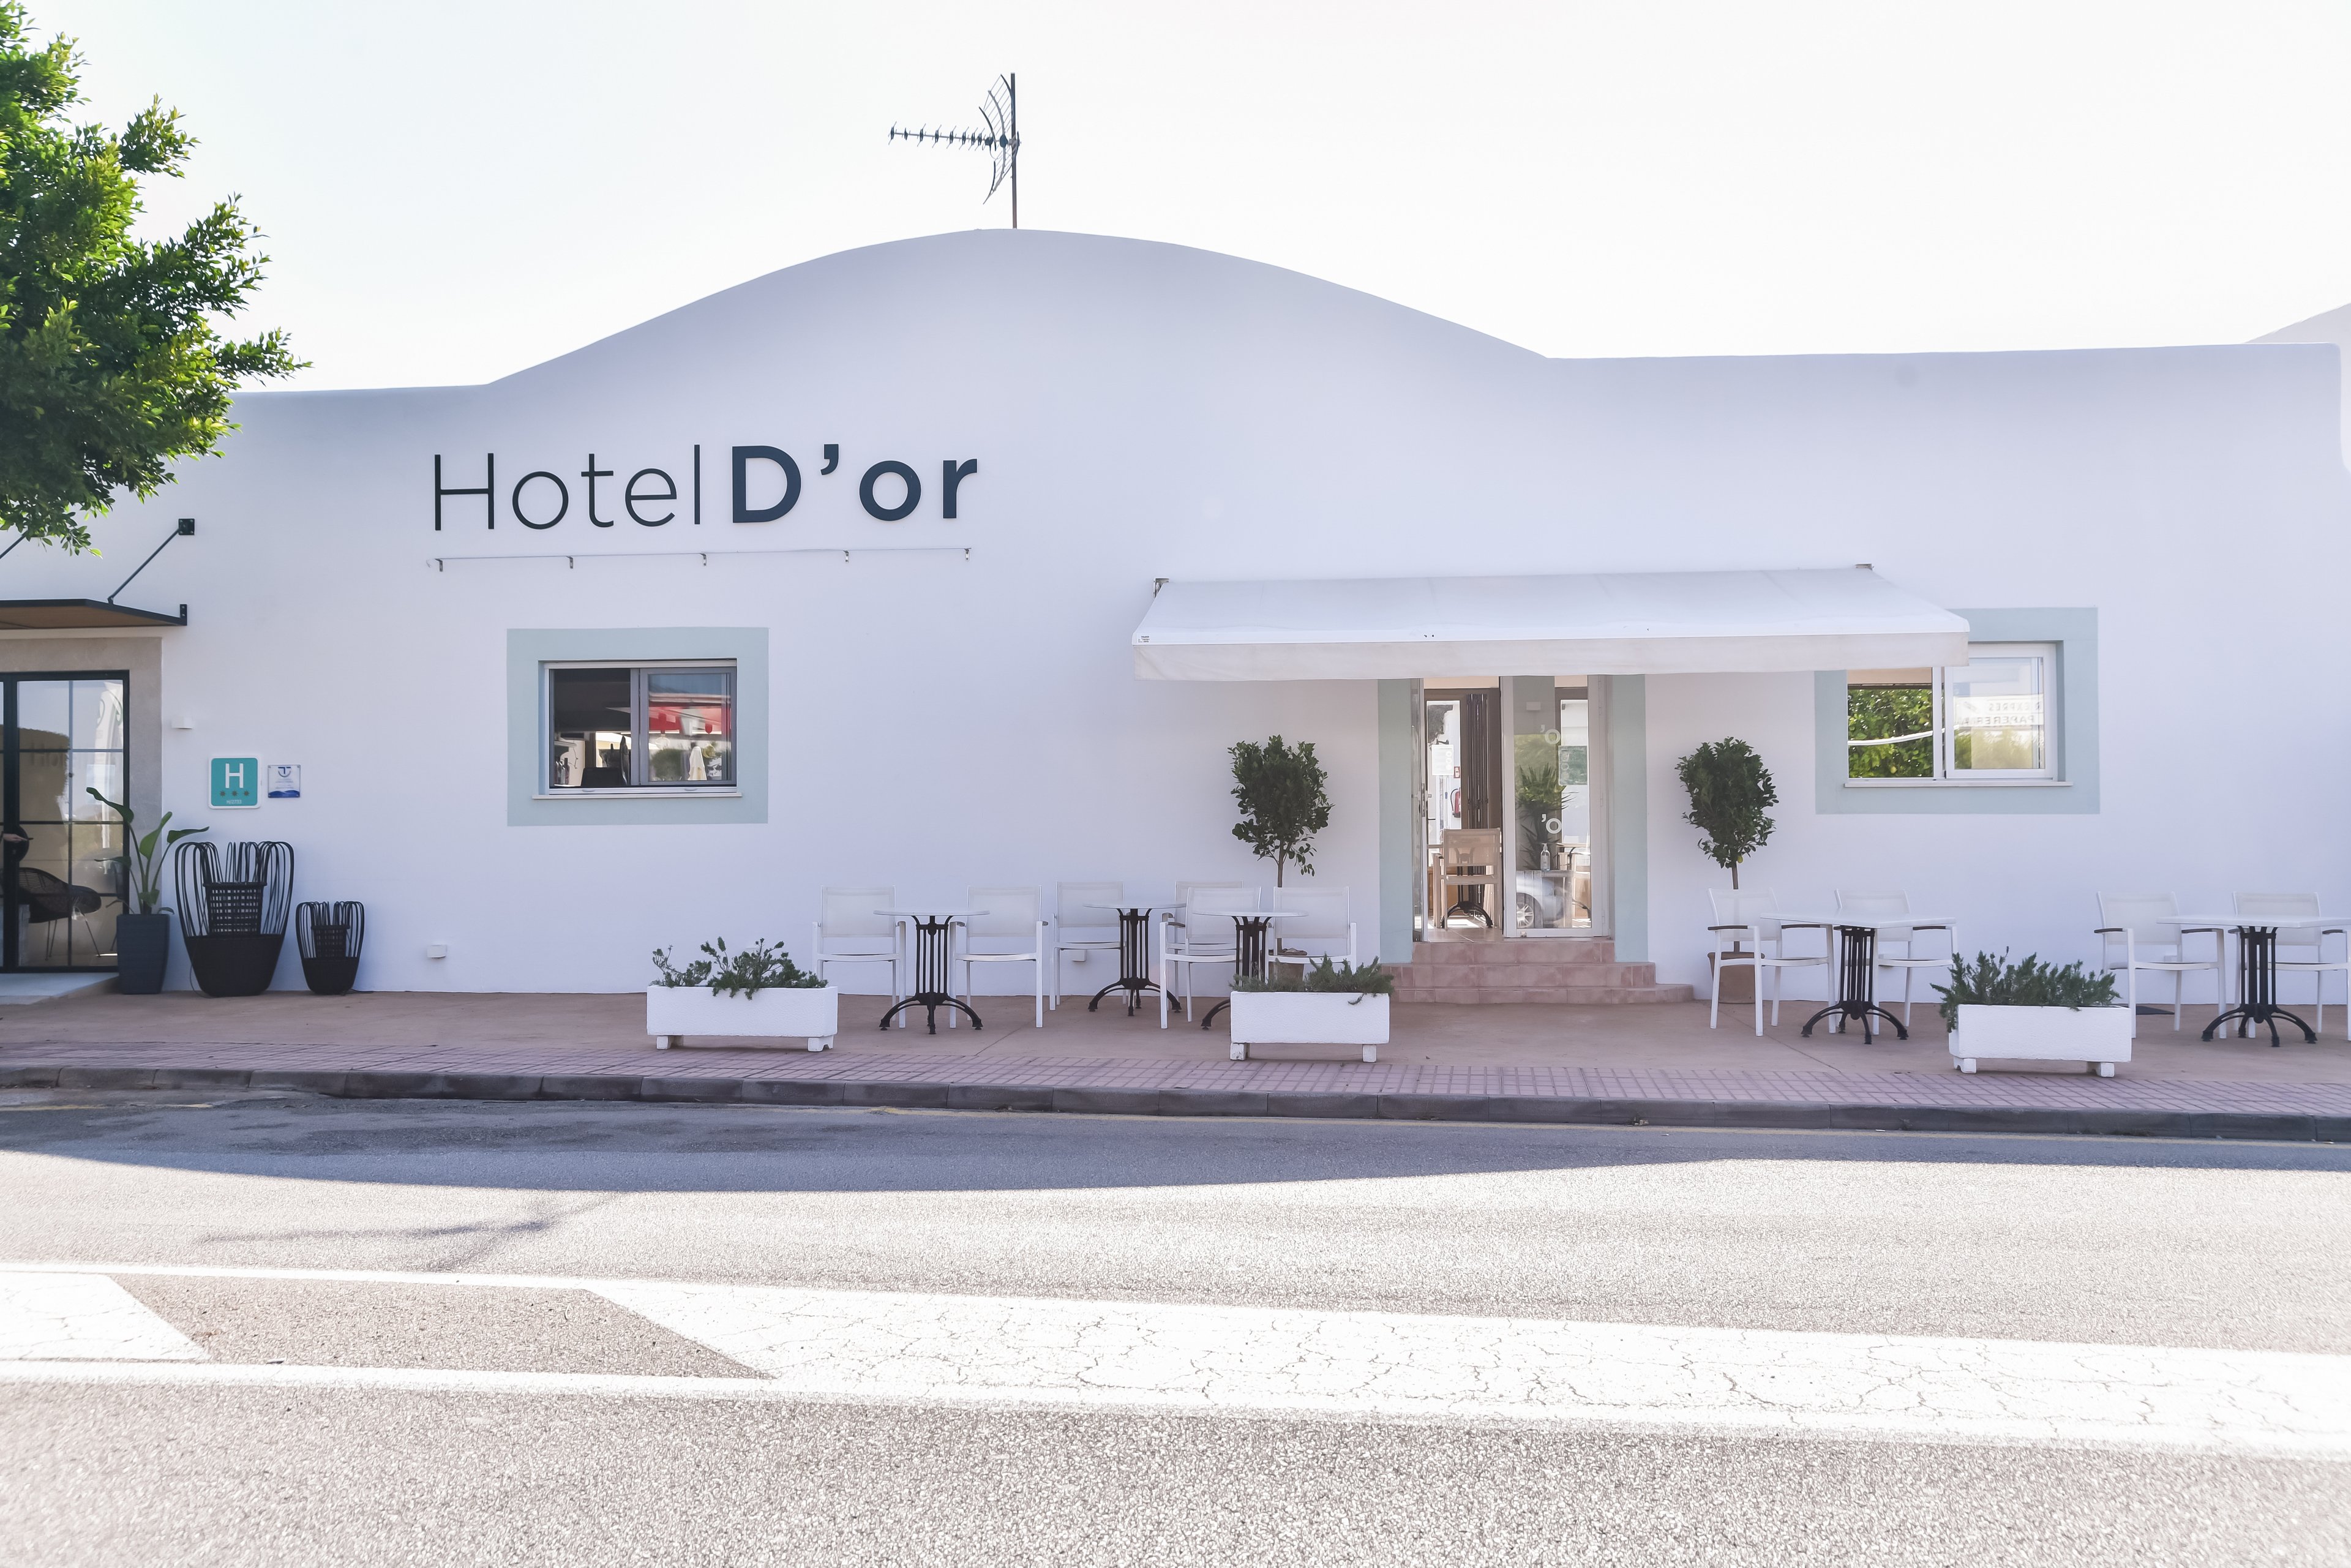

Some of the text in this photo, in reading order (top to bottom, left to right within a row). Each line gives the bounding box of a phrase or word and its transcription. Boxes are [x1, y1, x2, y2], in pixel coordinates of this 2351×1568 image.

[434, 443, 978, 531] Hotel D'or
[225, 763, 244, 789] H
